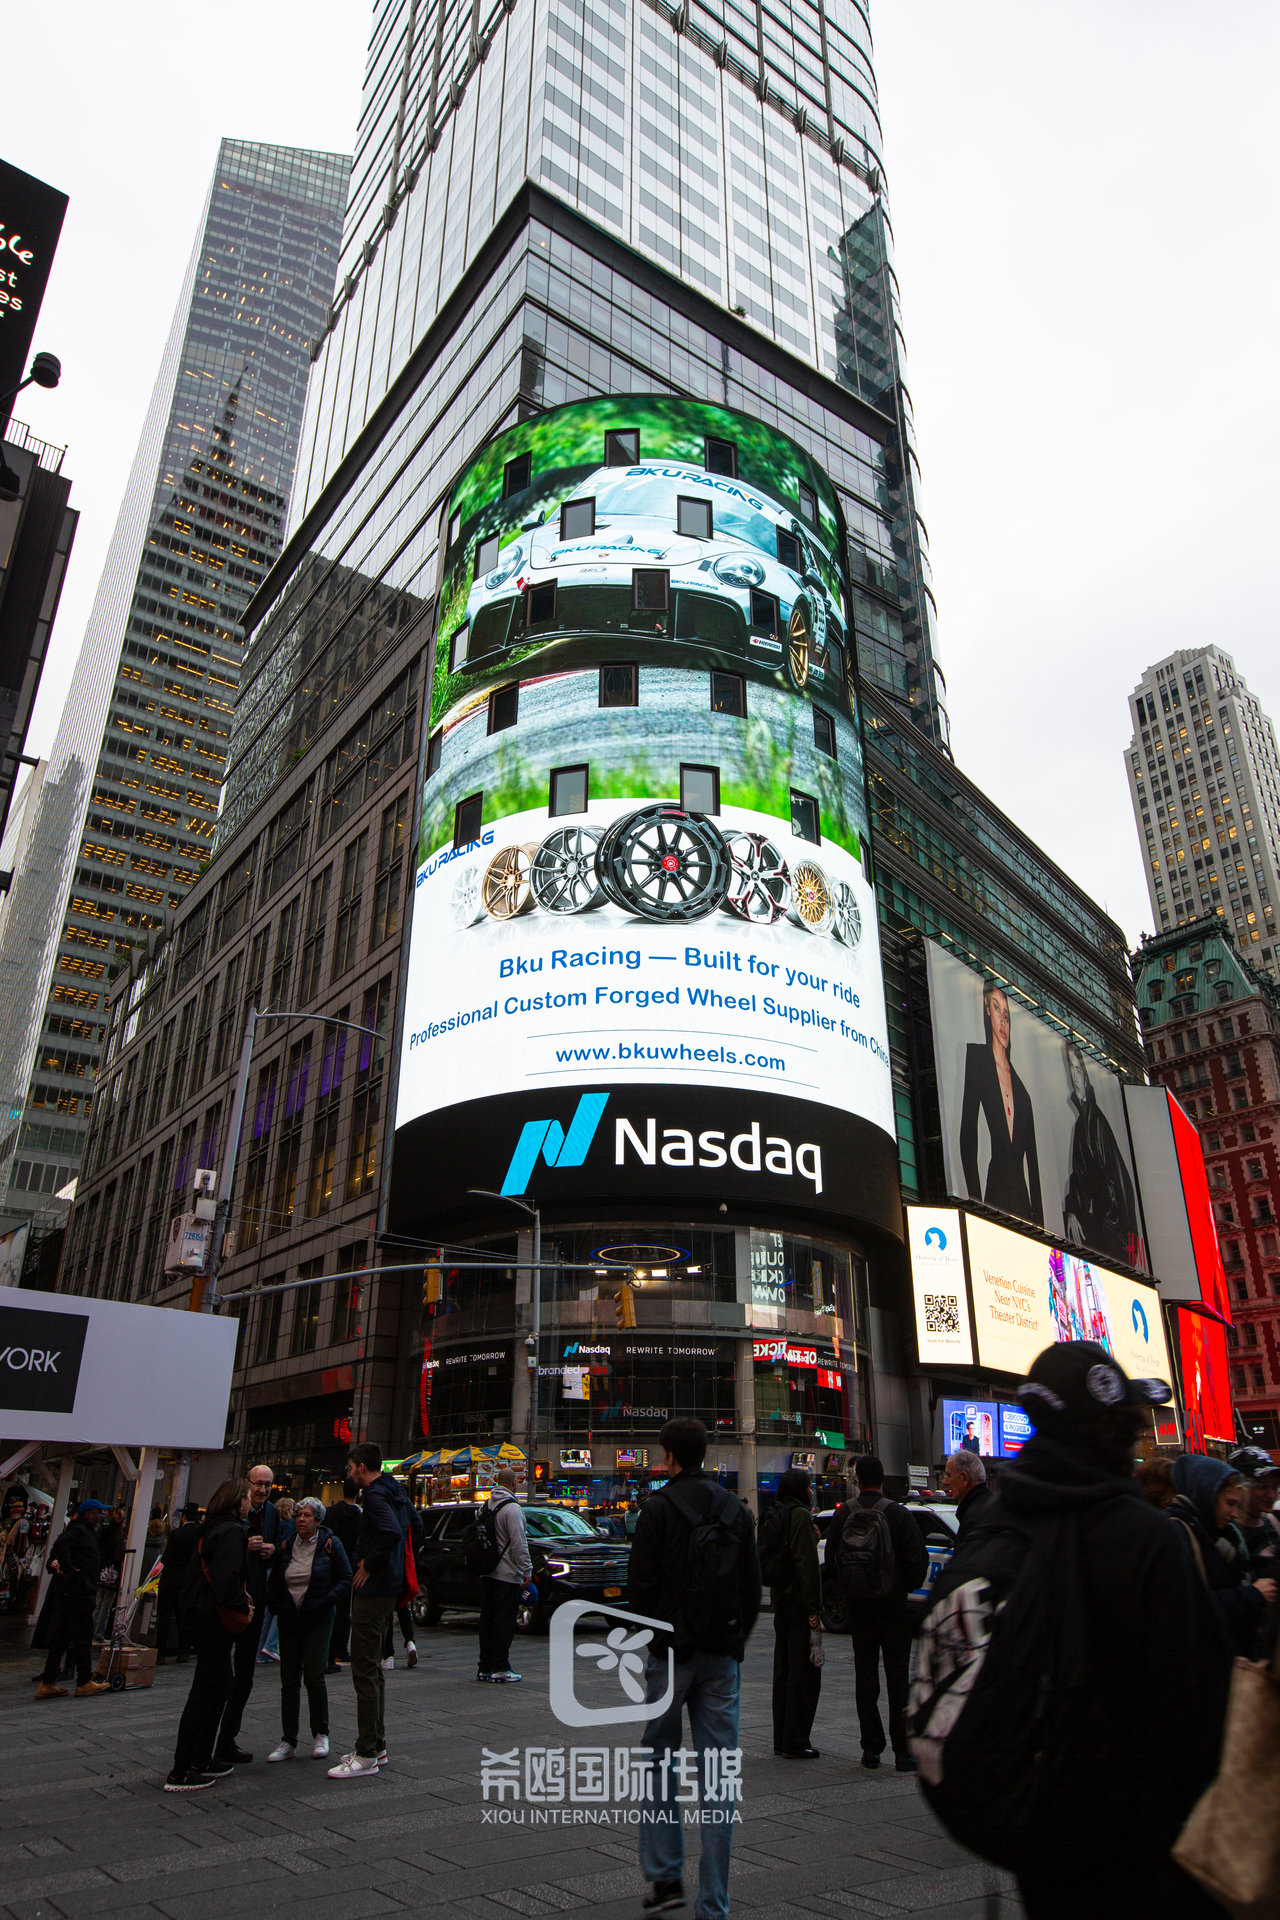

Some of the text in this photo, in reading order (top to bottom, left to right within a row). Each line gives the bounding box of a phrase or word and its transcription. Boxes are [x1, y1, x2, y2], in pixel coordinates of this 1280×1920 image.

[499, 956, 543, 978] Bku
[551, 946, 641, 969] Racing
[684, 947, 742, 971] Built
[747, 955, 780, 977] for
[785, 967, 828, 992] your
[832, 982, 860, 1008] ride
[410, 1001, 498, 1050] Professional
[504, 992, 587, 1014] Custom
[595, 987, 680, 1008] Forged
[687, 987, 756, 1012] Wheel
[763, 997, 837, 1031] Supplier
[840, 1020, 868, 1048] from
[555, 1042, 786, 1071] www.bkuwheels.com
[615, 1118, 823, 1194] Nasdaq
[982, 1269, 1036, 1298] Venetian Cuisine
[993, 1289, 1010, 1306] Near
[989, 1305, 1039, 1331] Theater District
[578, 1345, 716, 1355] Nasdaq REWRITE TOMORROW
[538, 1364, 580, 1376] branded
[623, 1405, 668, 1420] Nasdaq
